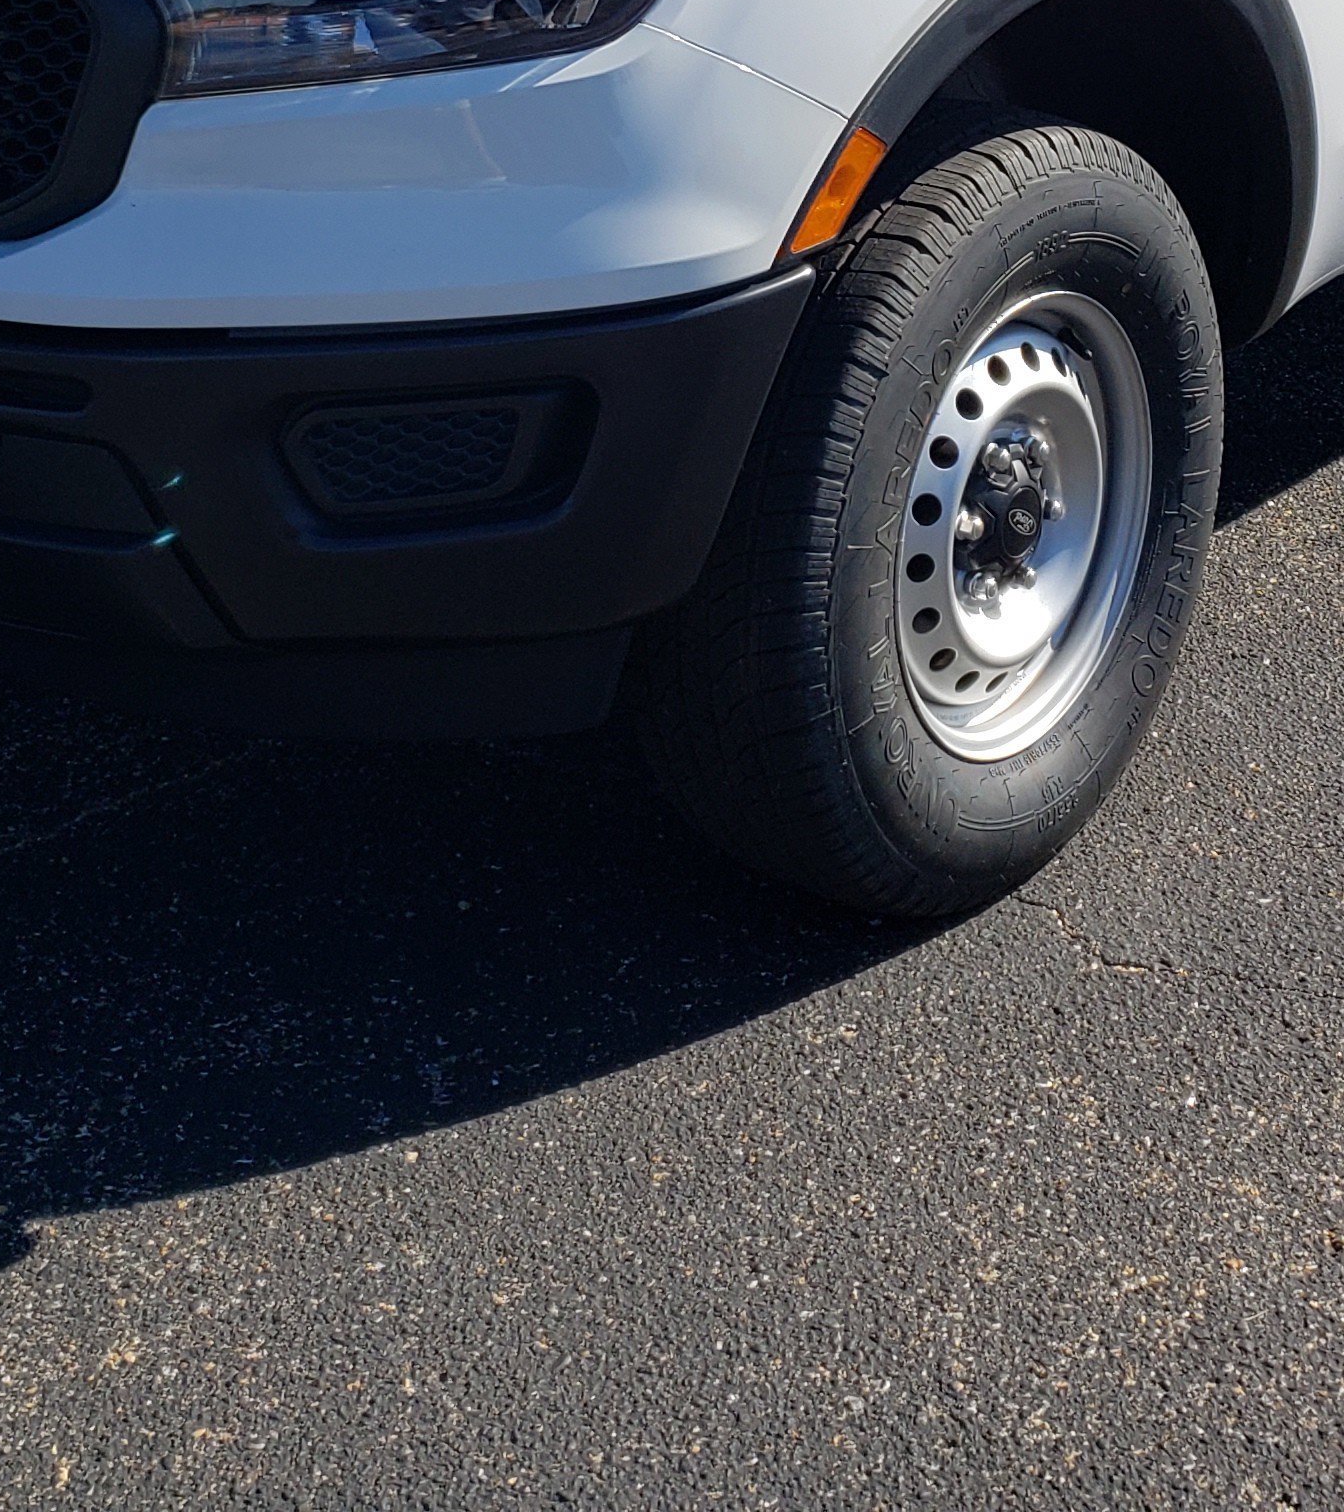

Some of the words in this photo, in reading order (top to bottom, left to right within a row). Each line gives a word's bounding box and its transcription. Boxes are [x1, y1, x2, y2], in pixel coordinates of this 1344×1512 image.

[1133, 236, 1210, 452] UNROYAL
[866, 336, 957, 599] LAREDO
[1130, 466, 1211, 699] LAREDO
